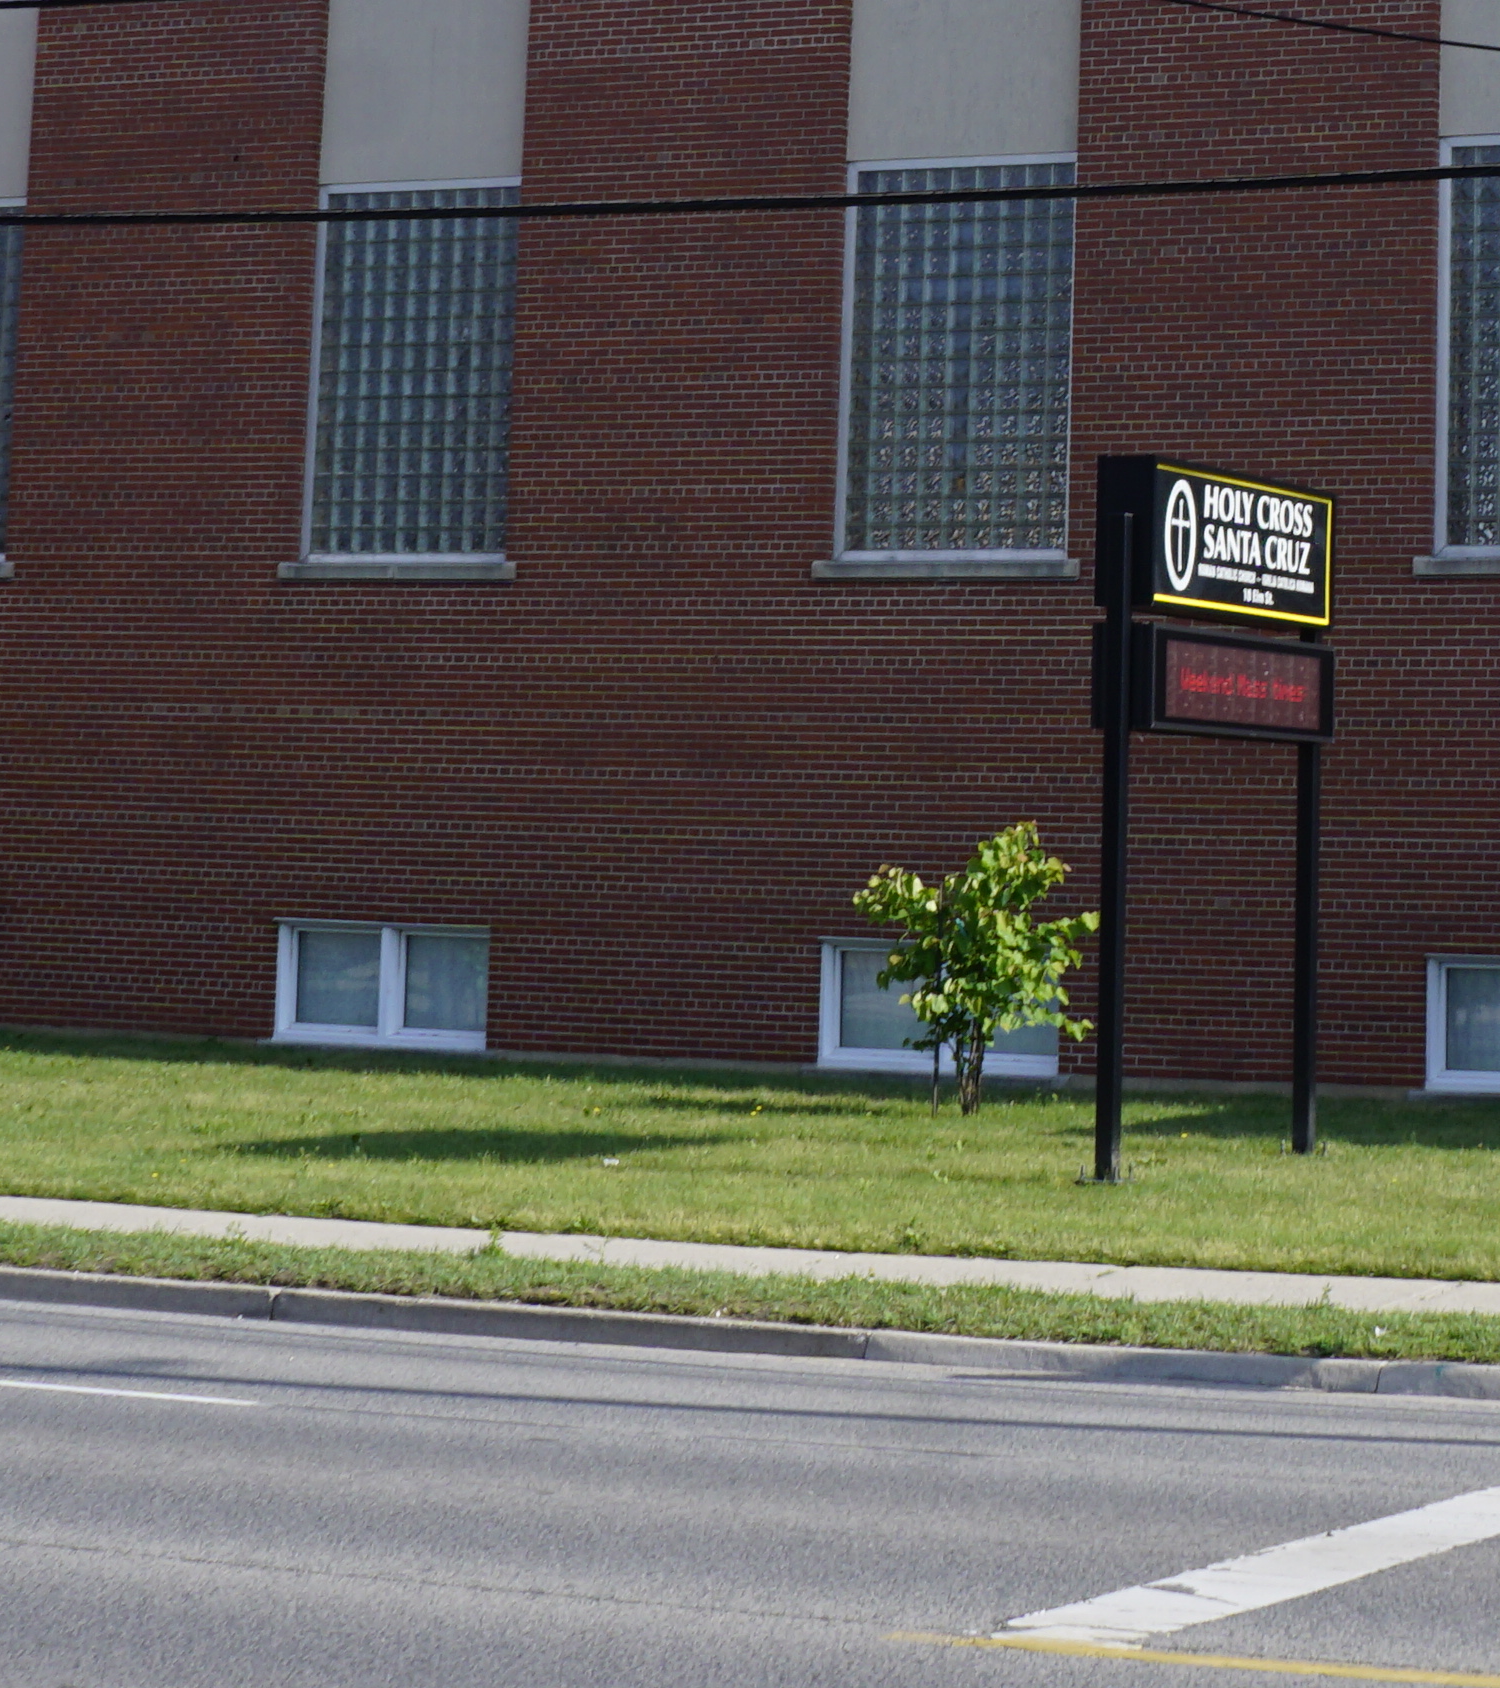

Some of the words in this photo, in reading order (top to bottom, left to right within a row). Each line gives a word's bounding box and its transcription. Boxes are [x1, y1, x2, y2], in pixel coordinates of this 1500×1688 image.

[1203, 483, 1255, 525] HOLY
[1257, 494, 1314, 538] CROSS
[1203, 523, 1262, 567] SANTA
[1264, 535, 1311, 575] CRUZ
